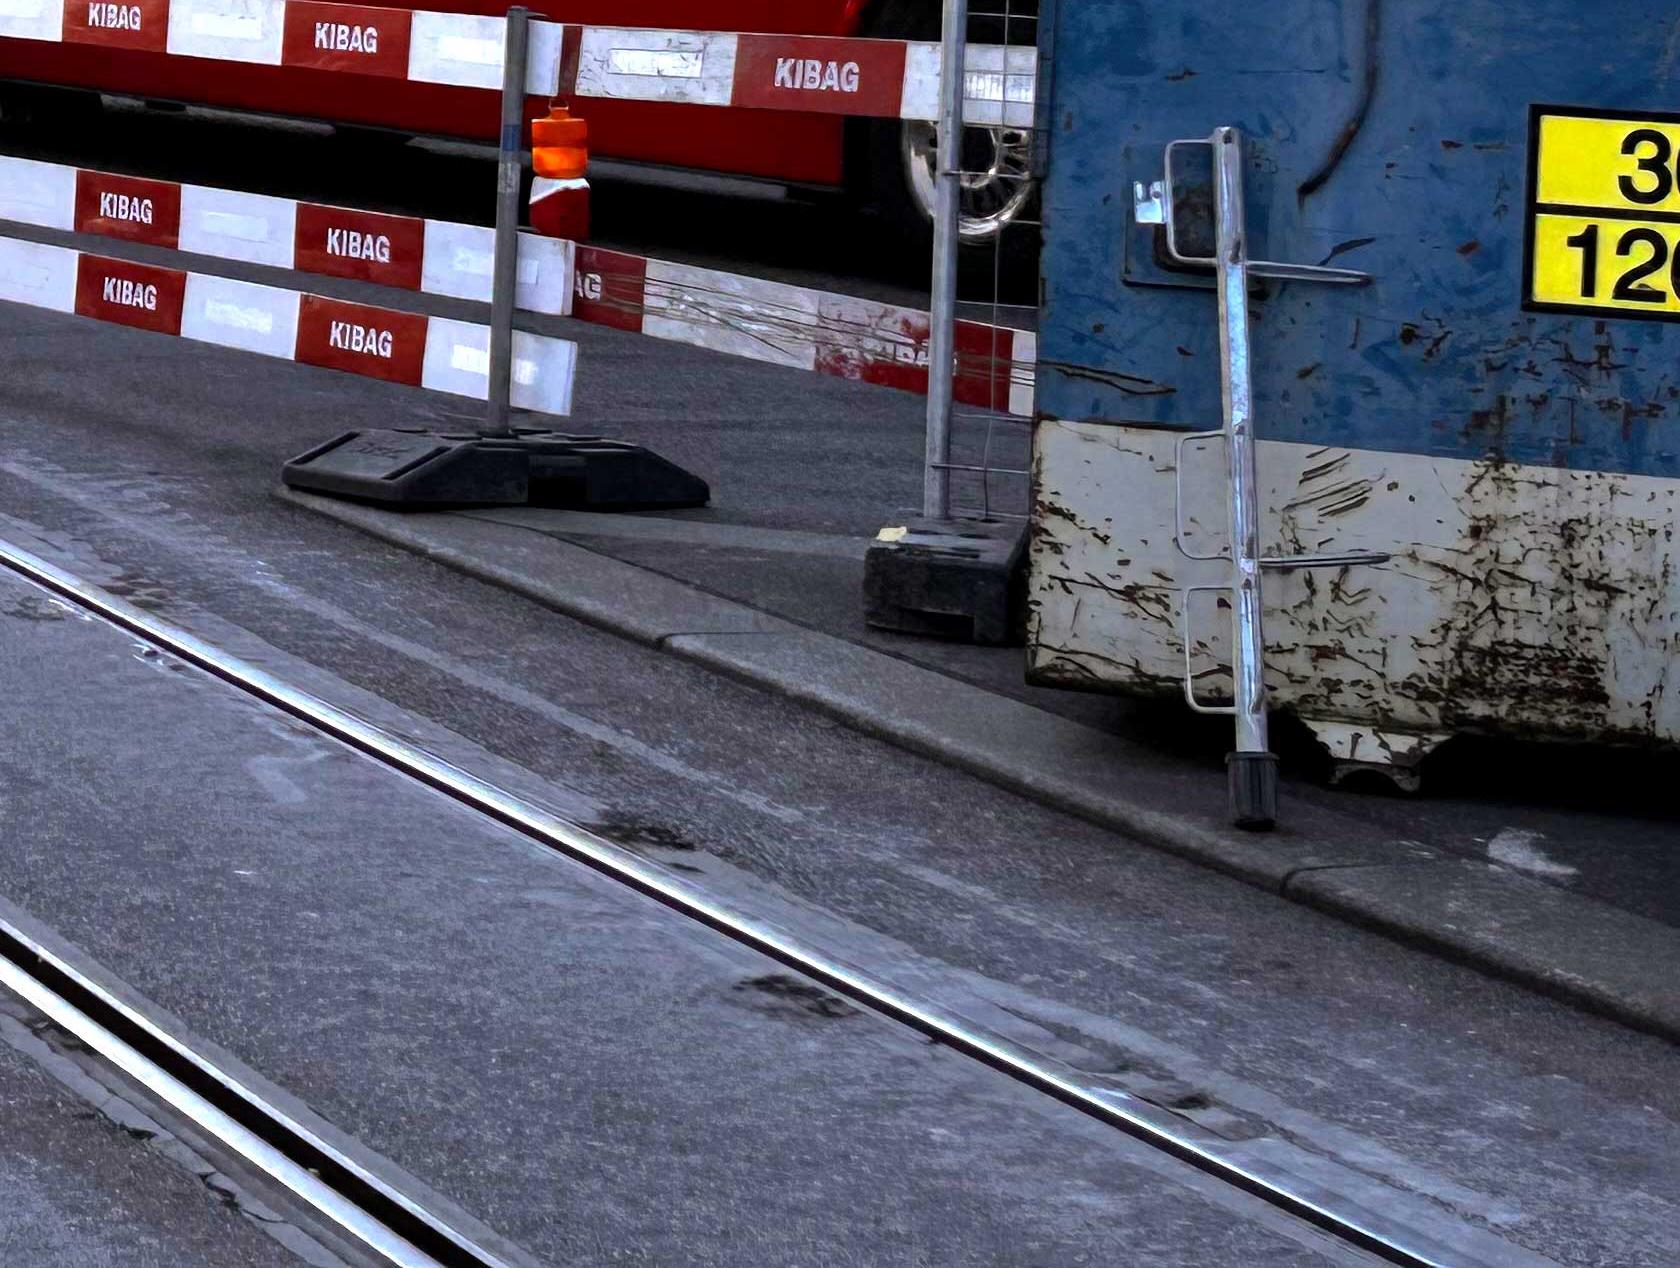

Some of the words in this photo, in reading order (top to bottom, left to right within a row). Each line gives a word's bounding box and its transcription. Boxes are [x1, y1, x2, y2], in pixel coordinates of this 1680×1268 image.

[88, 2, 141, 30] KIBAG
[314, 22, 378, 53] KIBAG
[774, 58, 859, 92] KIBAG
[1618, 129, 1680, 205] 3
[100, 192, 152, 224] KIBAG
[327, 228, 390, 263] KIBAG
[1566, 224, 1680, 303] 12
[103, 277, 157, 310] KIBAG
[329, 321, 392, 357] KIBAG
